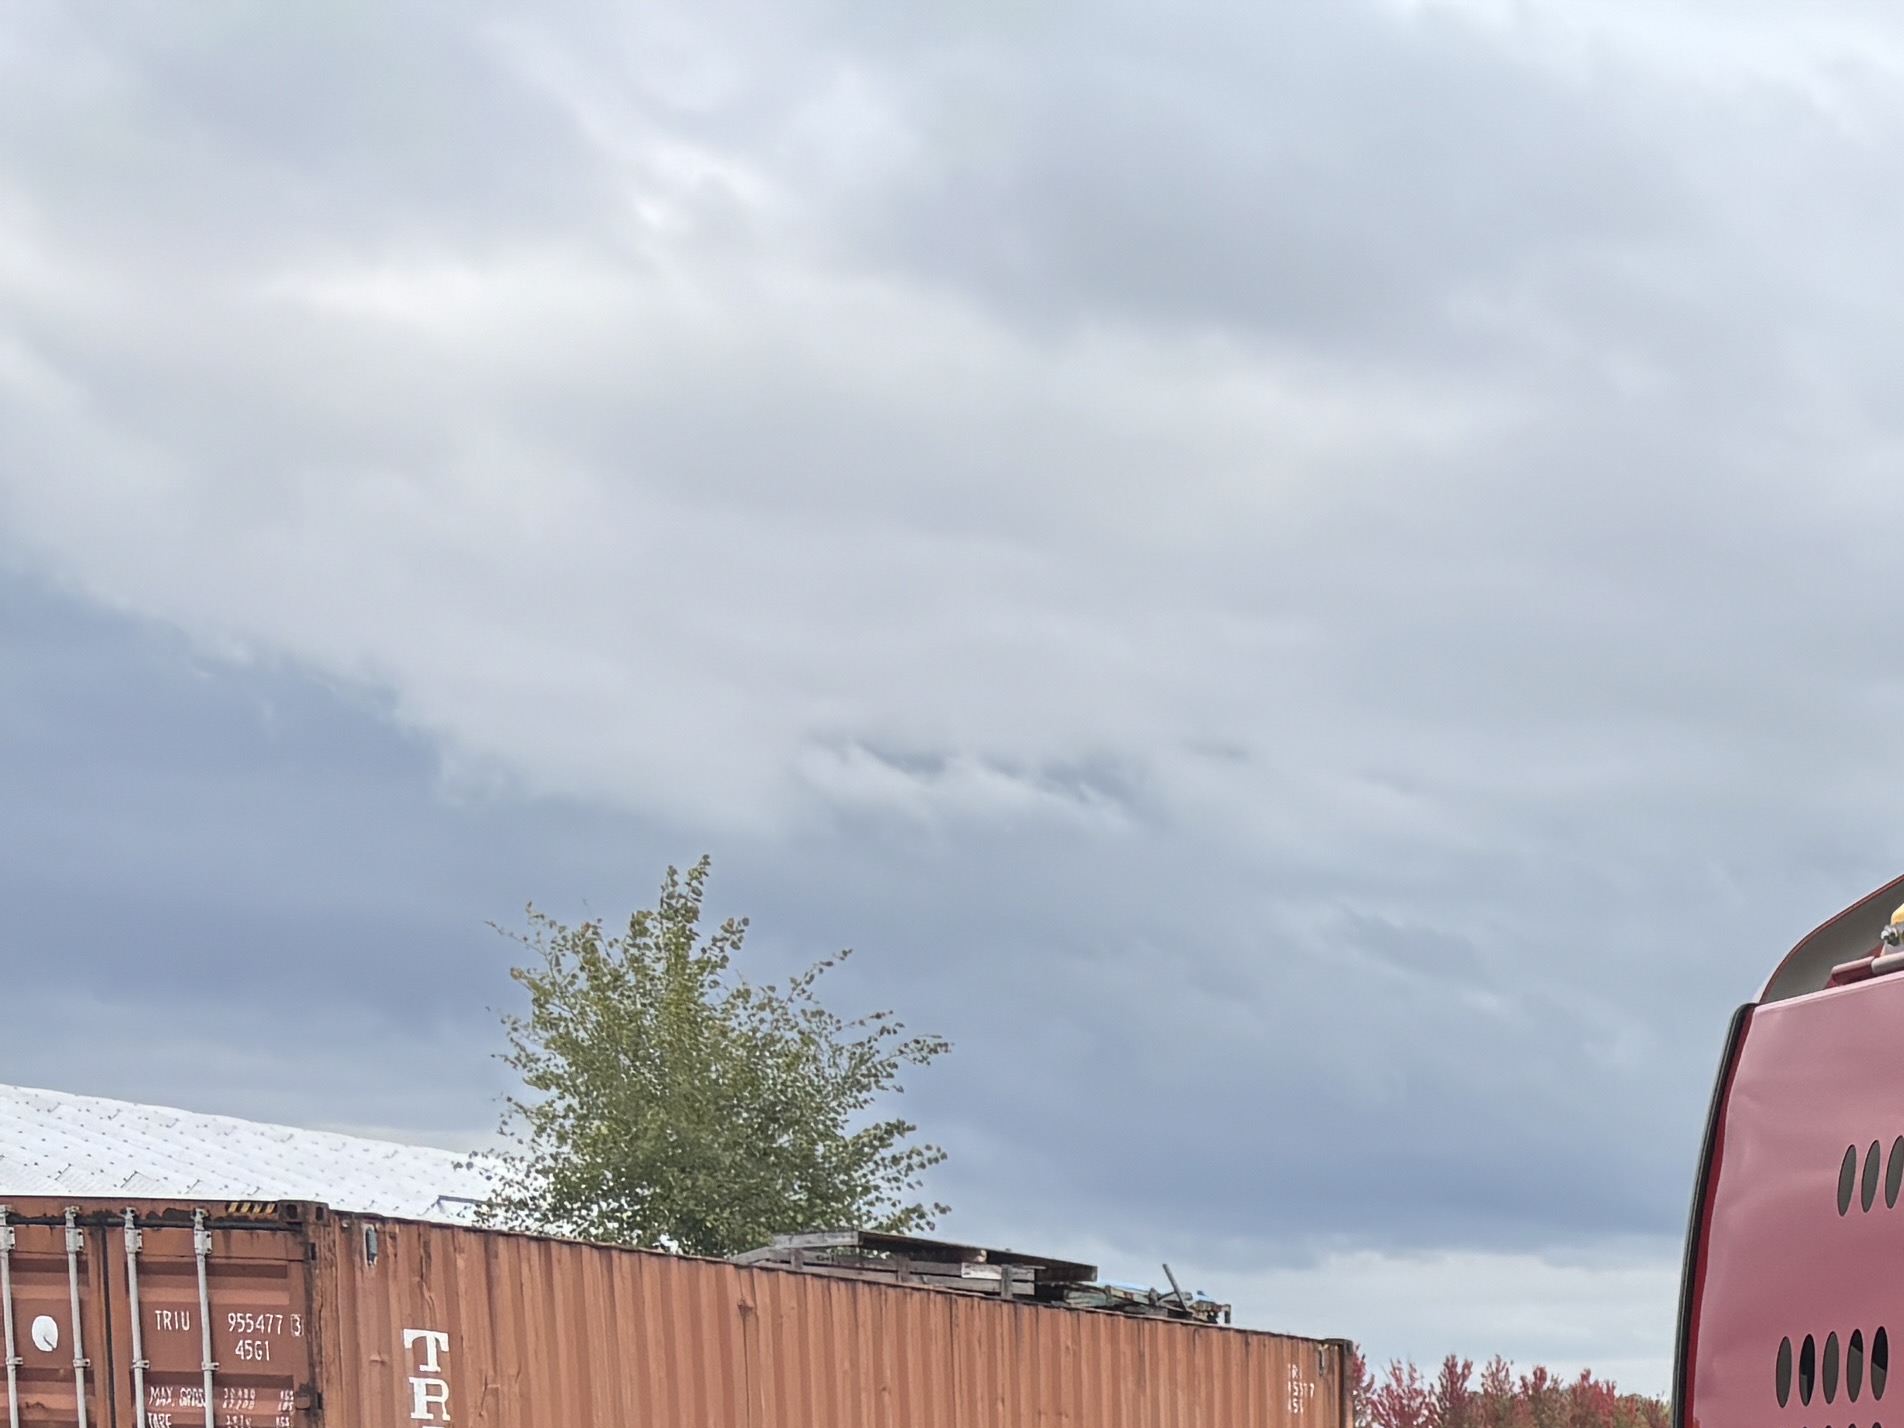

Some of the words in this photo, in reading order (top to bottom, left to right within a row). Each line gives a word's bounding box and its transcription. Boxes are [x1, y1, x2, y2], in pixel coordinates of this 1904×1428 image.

[154, 1310, 191, 1331] TRIU
[227, 1312, 284, 1335] 955477
[291, 1315, 302, 1336] 3
[234, 1339, 271, 1361] 45G1
[179, 1387, 206, 1408] GROS
